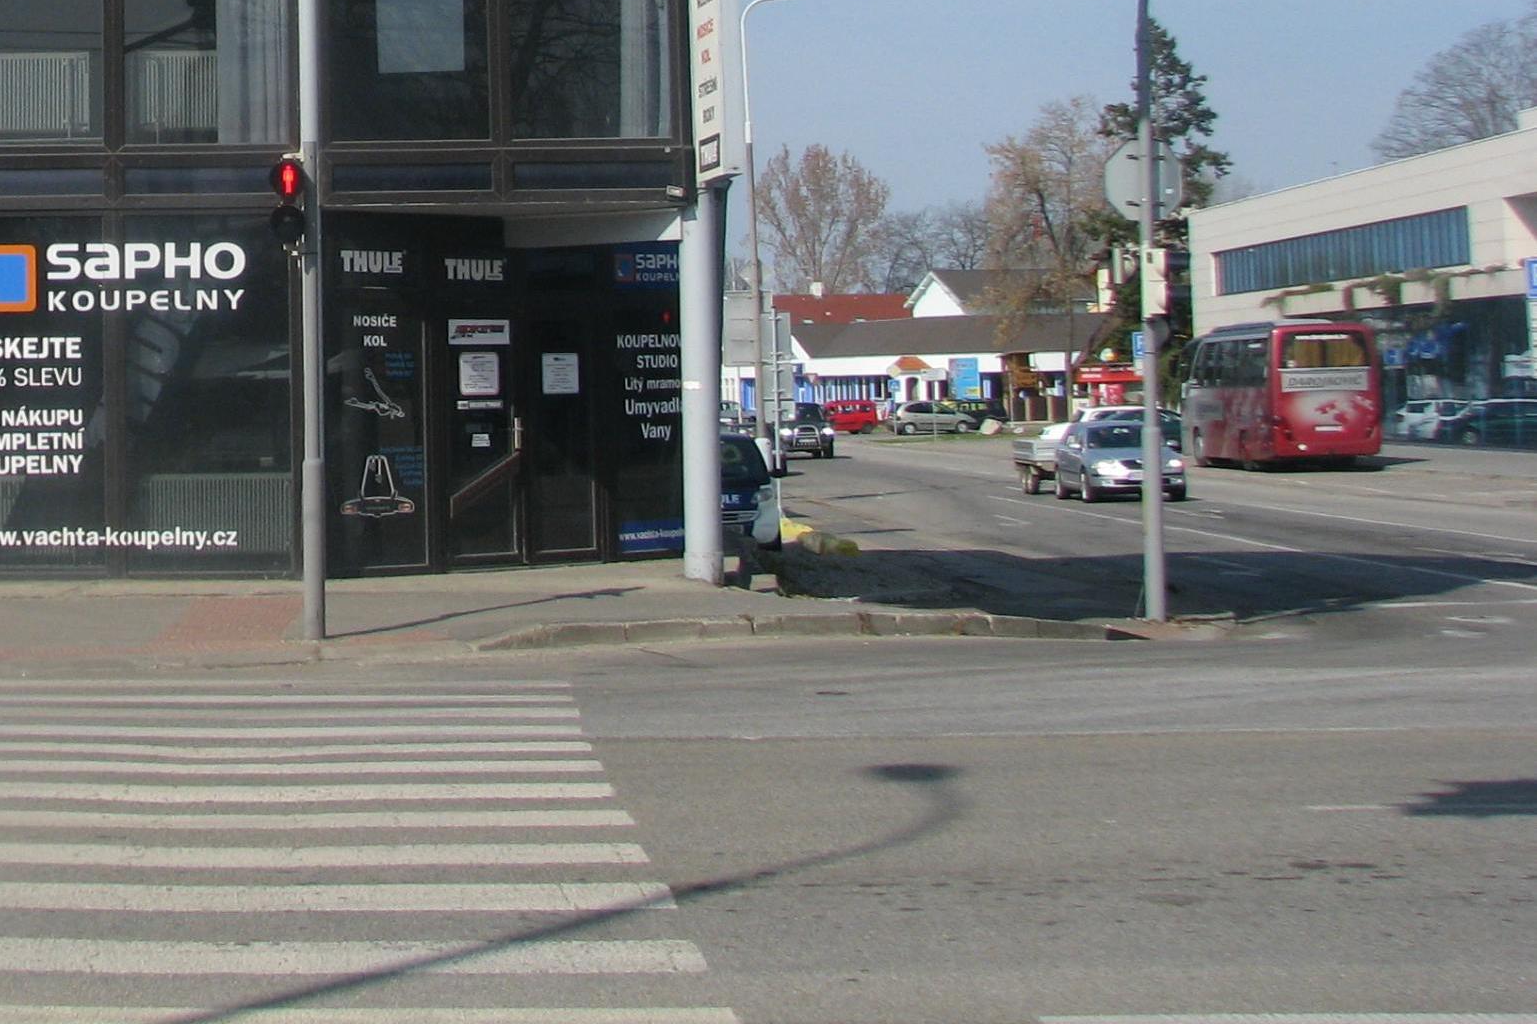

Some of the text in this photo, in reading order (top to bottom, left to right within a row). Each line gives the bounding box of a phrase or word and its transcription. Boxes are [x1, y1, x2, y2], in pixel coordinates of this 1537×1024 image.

[340, 250, 403, 274] THULE
[444, 258, 504, 281] THULE
[47, 288, 245, 312] KOUPELNY
[353, 313, 397, 327] NOSIČE
[363, 334, 388, 347] KOL
[636, 355, 678, 369] STUDIO
[14, 367, 83, 386] SLEVU
[1, 405, 83, 426] NÁKUPU
[641, 423, 672, 441] Vany
